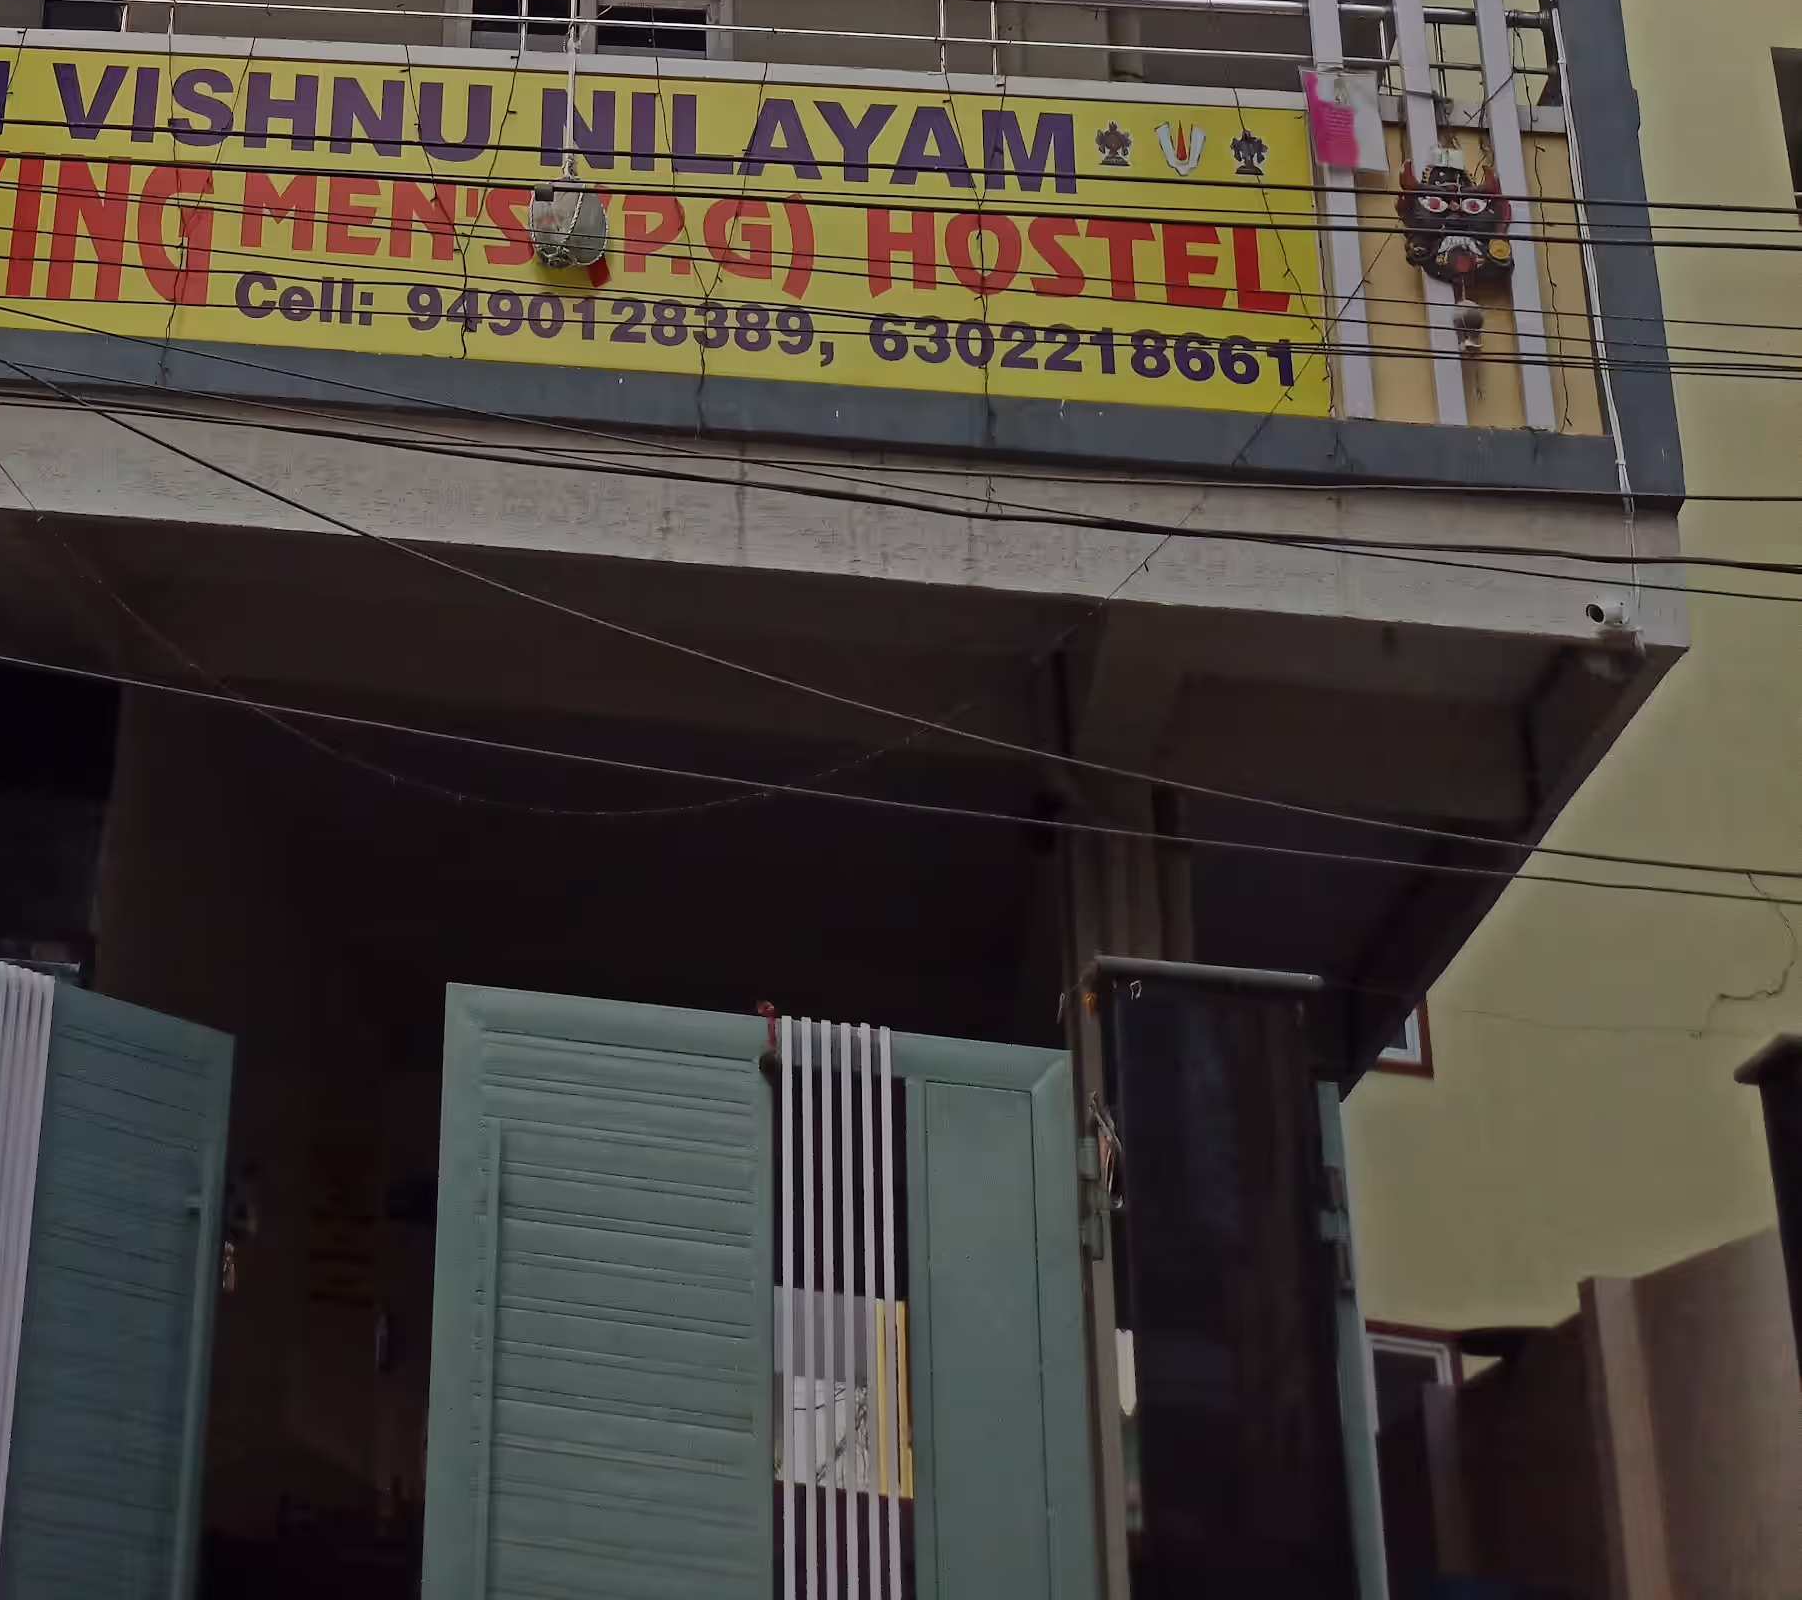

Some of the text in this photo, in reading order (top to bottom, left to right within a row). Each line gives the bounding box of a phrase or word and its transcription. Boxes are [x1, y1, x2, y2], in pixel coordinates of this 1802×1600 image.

[53, 62, 496, 163] VISHNU
[540, 86, 1078, 195] NILAYAM
[867, 207, 1291, 313] HOSTEL
[235, 270, 1295, 387] Cell: 9490128389, 6302218661
